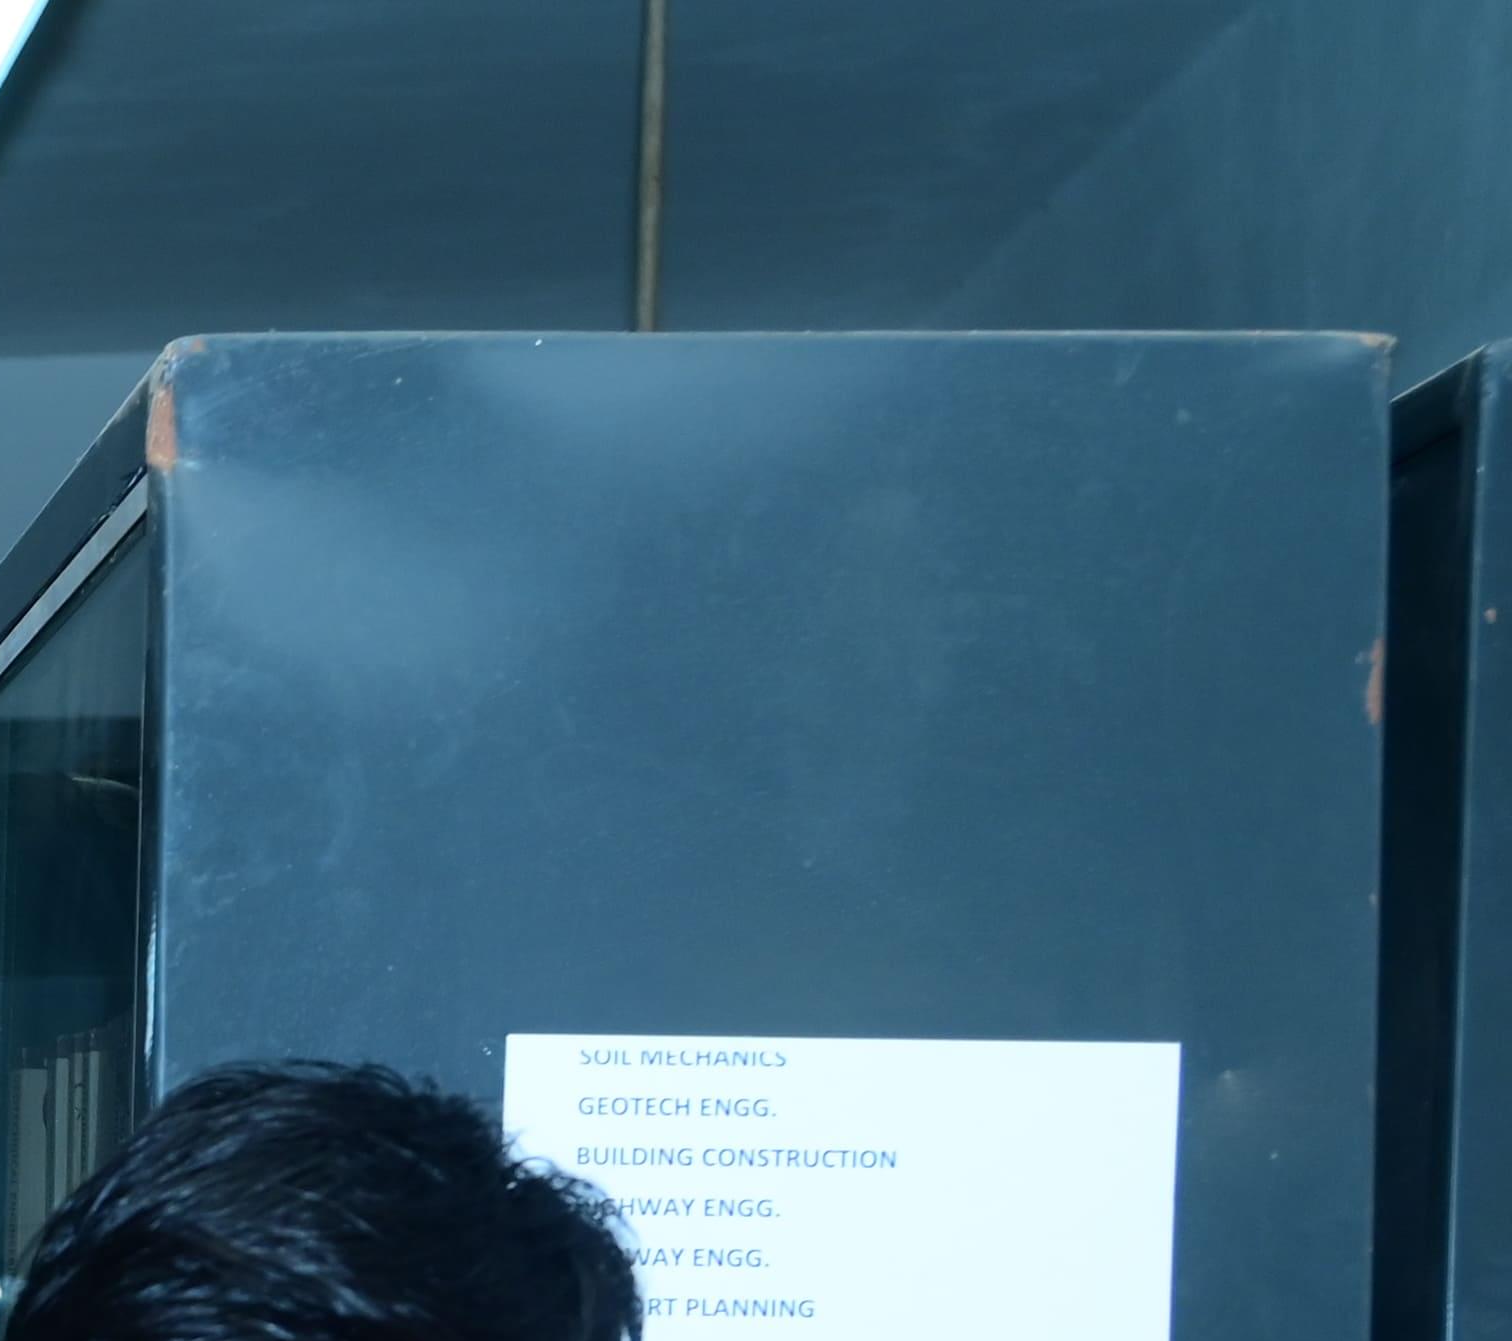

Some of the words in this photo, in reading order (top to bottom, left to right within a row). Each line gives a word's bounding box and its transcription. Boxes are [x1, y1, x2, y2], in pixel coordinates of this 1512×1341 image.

[580, 1050, 631, 1066] SOIL
[641, 1050, 786, 1067] MECHANICS
[578, 1097, 690, 1116] GEOTECH
[700, 1098, 776, 1118] ENGG.
[577, 1147, 693, 1167] BUILDING
[702, 1148, 896, 1169] CONSTRUCTION
[704, 1198, 780, 1218] ENGG.
[693, 1248, 769, 1268] ENGG.
[686, 1298, 814, 1318] PLANNING
